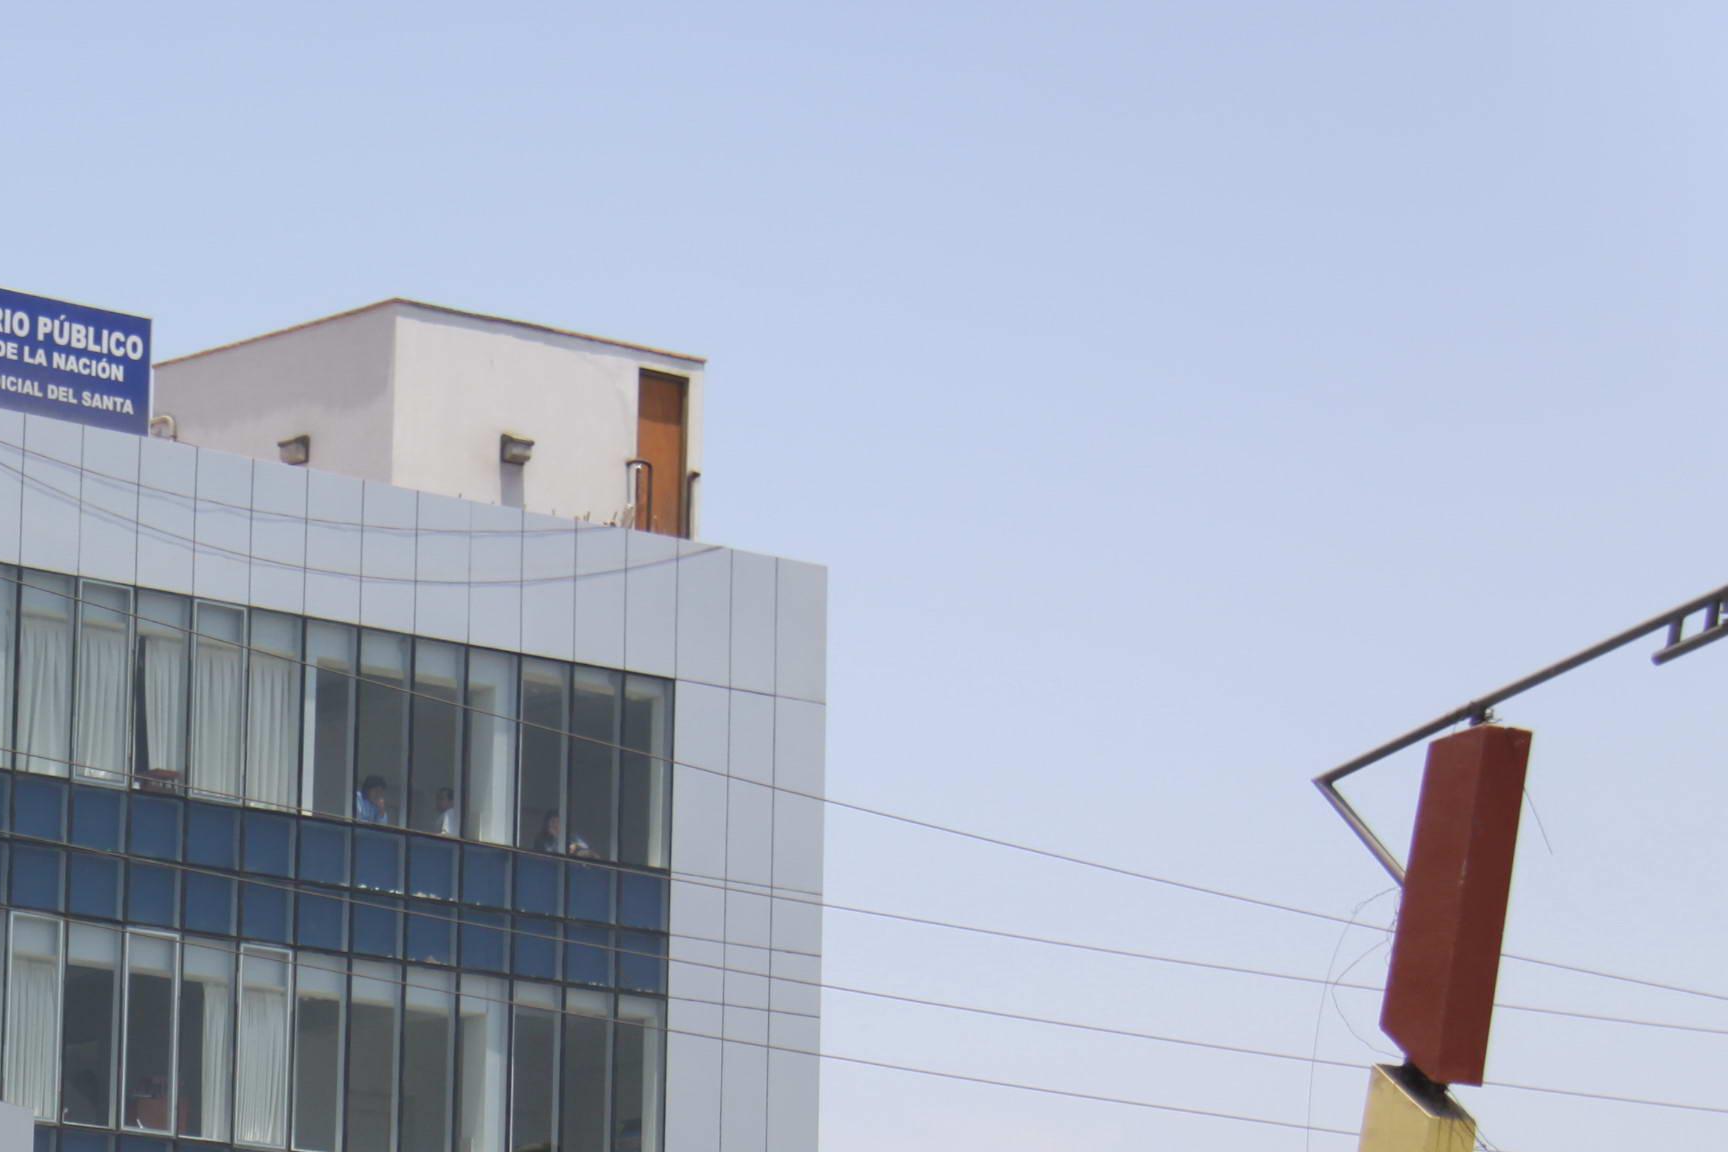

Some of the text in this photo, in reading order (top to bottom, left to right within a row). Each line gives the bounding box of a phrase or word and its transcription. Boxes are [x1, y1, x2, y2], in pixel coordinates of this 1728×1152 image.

[36, 314, 144, 361] PÚBLICO
[23, 345, 48, 367] LA
[52, 351, 125, 382] NACIÓN
[47, 383, 78, 404] DEL
[81, 391, 134, 415] SANTA
